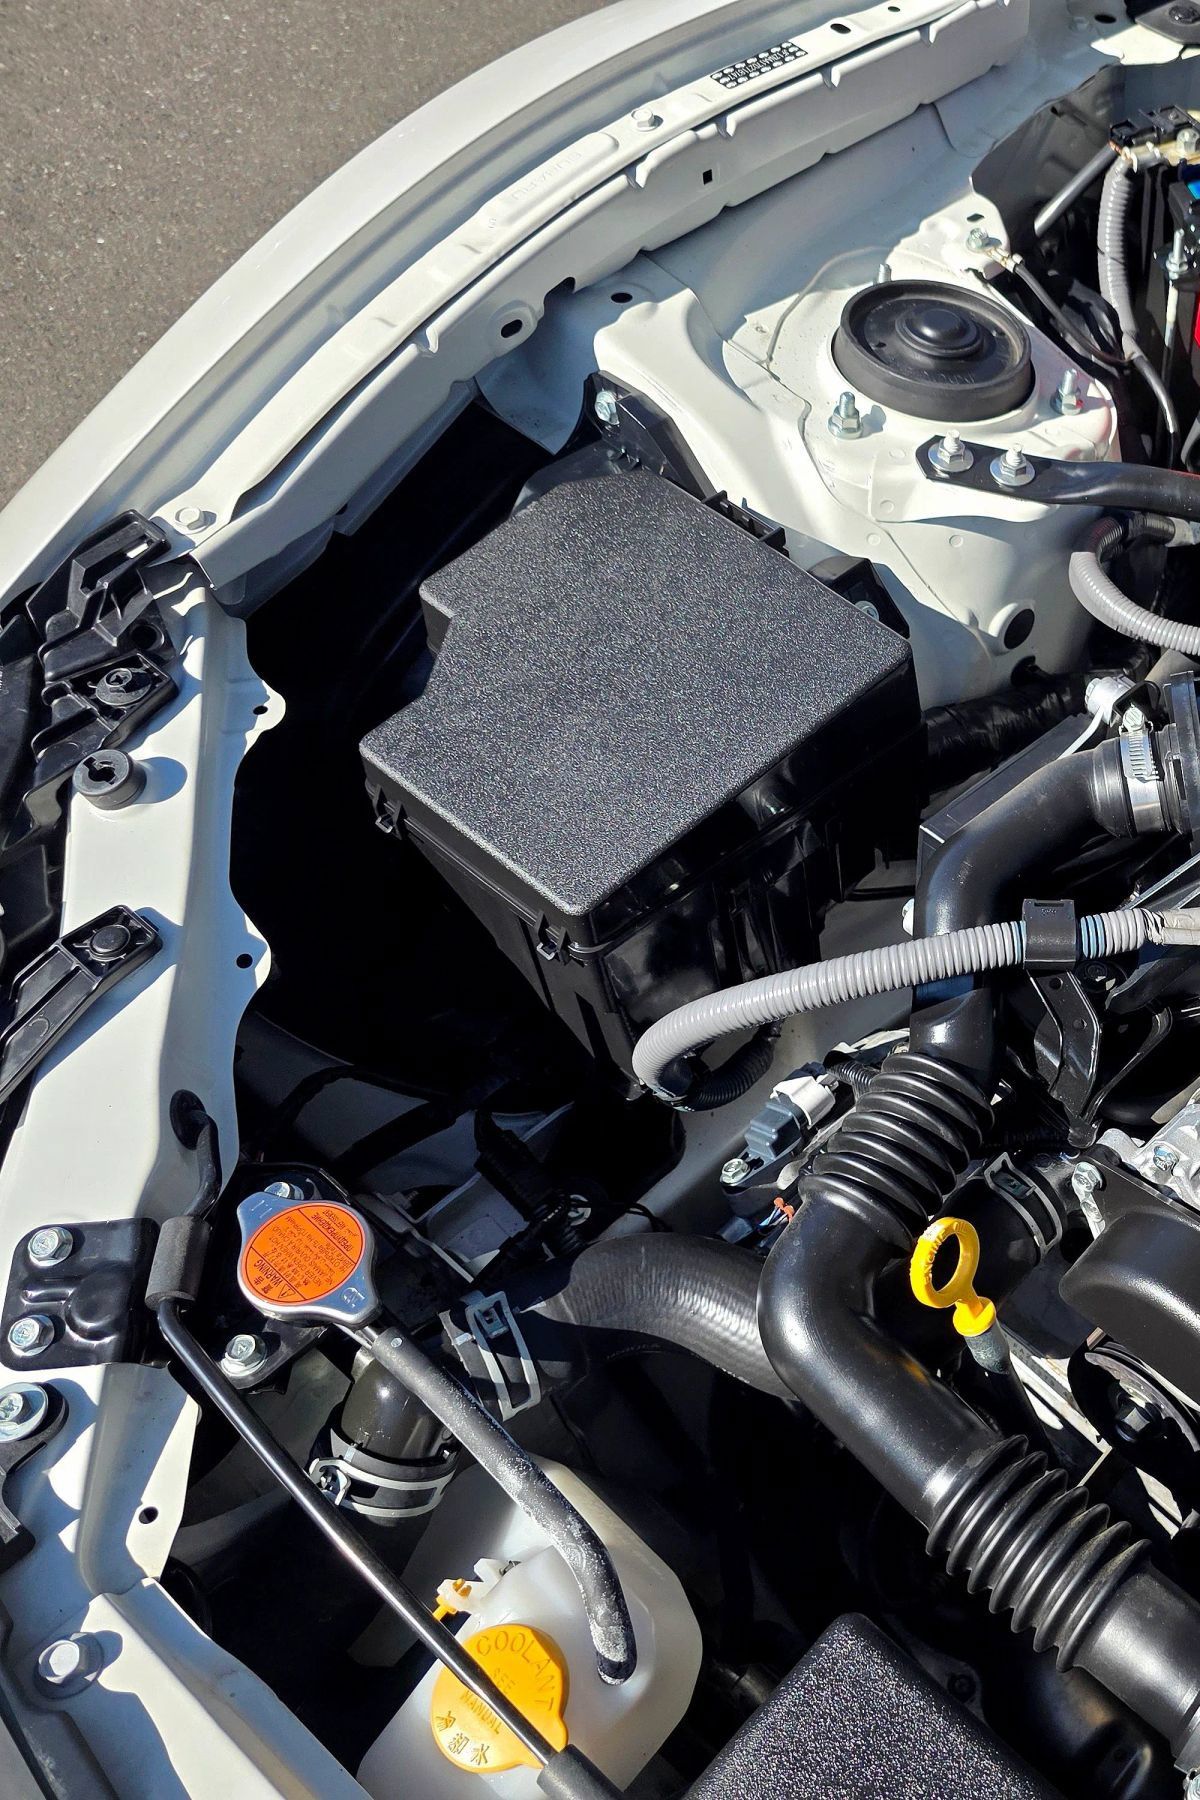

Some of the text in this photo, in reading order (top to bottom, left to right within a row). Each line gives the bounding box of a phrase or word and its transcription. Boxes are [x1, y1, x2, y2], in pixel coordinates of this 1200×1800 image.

[252, 1258, 283, 1287] WARNING
[476, 1630, 556, 1712] COOLANT
[492, 1667, 516, 1692] SEE
[459, 1690, 501, 1735] MANUAL
